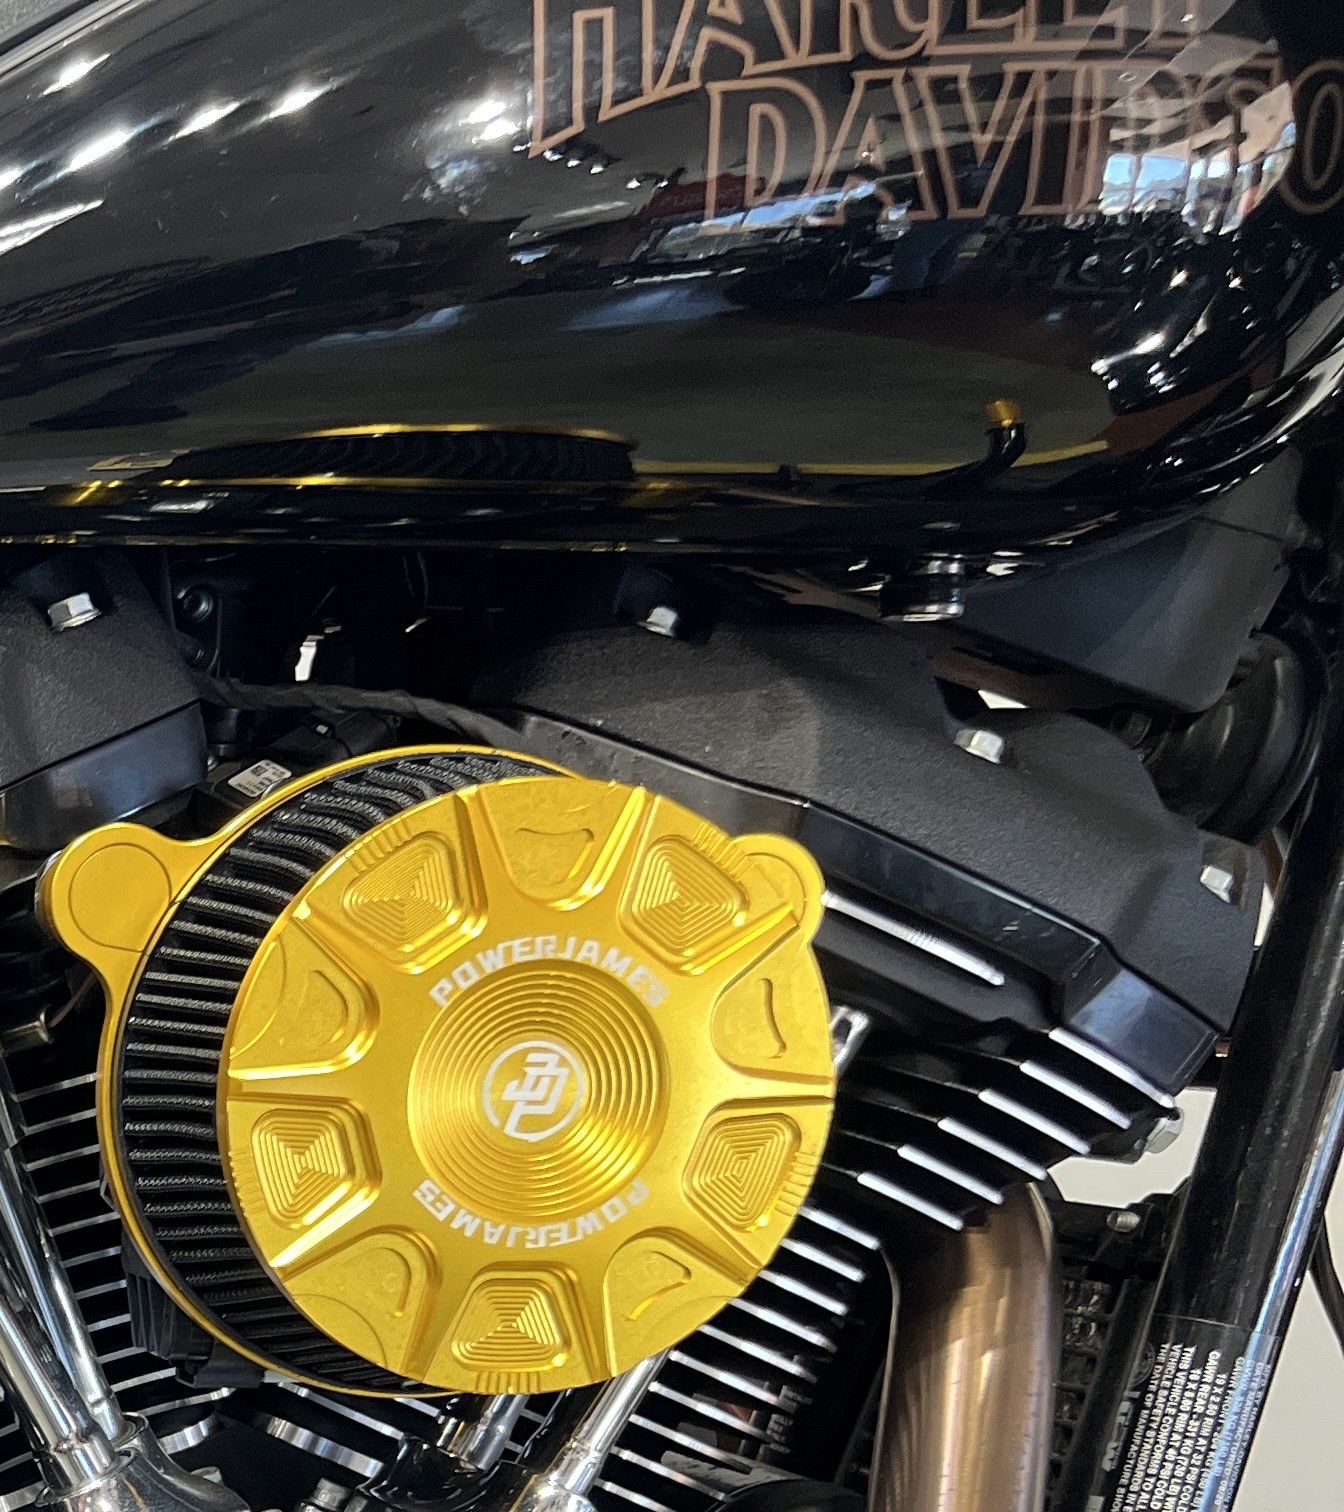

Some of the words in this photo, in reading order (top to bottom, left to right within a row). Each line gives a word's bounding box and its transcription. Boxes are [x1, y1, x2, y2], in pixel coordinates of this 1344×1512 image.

[427, 934, 671, 1008] POWERJAMES
[413, 1178, 650, 1249] POWERJAMES
[1155, 1342, 1170, 1363] THE
[1159, 1343, 1183, 1389] VEHICLE
[1177, 1344, 1197, 1370] THIS
[1146, 1365, 1164, 1391] DATE
[1200, 1351, 1222, 1383] GAWR
[1227, 1357, 1245, 1388] GAWR
[1249, 1363, 1264, 1388] DATE
[1163, 1371, 1189, 1415] VEHICLE
[1191, 1385, 1212, 1413] REAR
[1216, 1390, 1235, 1423] FRONT
[1147, 1390, 1169, 1428] SAFETY
[1172, 1413, 1189, 1432] RIM
[1184, 1420, 1201, 1436] 331
[1198, 1418, 1215, 1436] RIM
[1117, 1409, 1150, 1485] MANUFACTURE
[1145, 1417, 1175, 1475] CONFORMS
[1223, 1408, 1259, 1501] HARLEY-DAVIDSON
[1128, 1430, 1157, 1492] STANDARDS
[1158, 1463, 1174, 1479] PSI
[1170, 1457, 1189, 1477] (730
[1164, 1480, 1182, 1496] LB)
[1184, 1468, 1200, 1484] PSI
[1134, 1493, 1151, 1512] ALL
[1148, 1481, 1168, 1510] COLD
[1189, 1491, 1205, 1507] LB)
